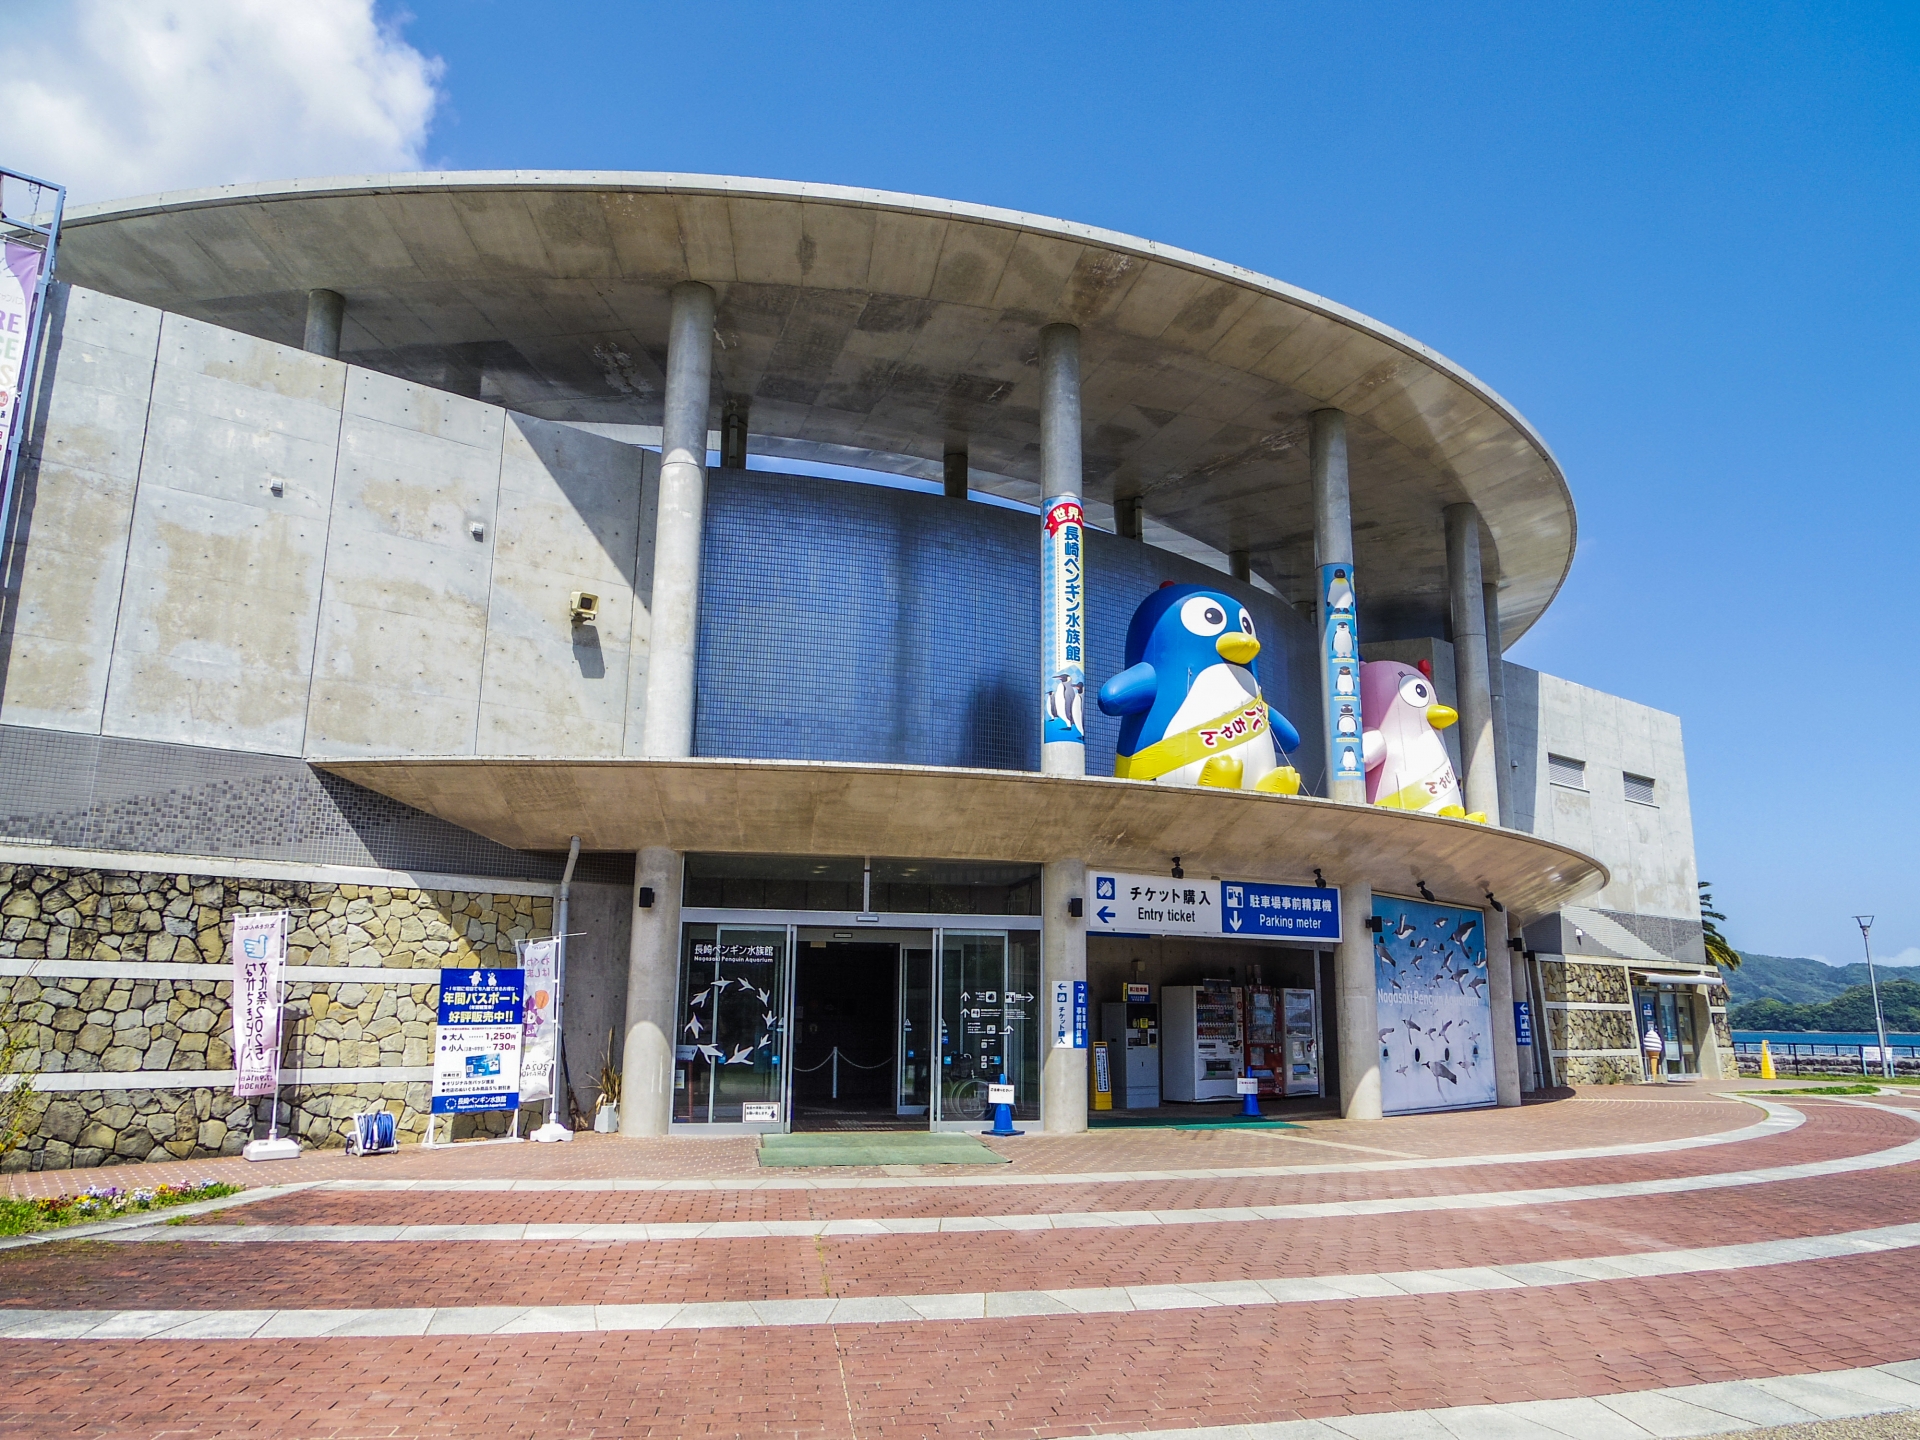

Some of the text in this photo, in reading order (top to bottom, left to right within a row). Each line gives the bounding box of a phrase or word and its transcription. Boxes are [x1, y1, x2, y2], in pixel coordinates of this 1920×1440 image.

[1063, 525, 1081, 662] 長崎ペンギン水族館
[1129, 885, 1211, 906] チケット購入
[1249, 894, 1332, 913] 駐車場事前精算機
[1137, 907, 1196, 923] Entry ticket
[1259, 914, 1322, 929] Parking meter
[694, 944, 774, 956] 長崎ペンギン水族館
[443, 991, 520, 1005] 年間パスポート
[1377, 988, 1479, 1007] Nagasaki Penguin Aquarium
[448, 1010, 514, 1023] 好評販売中!!
[1058, 1006, 1066, 1045] チケット購入
[449, 1033, 465, 1041] 大人
[485, 1032, 516, 1041] 1,250円
[448, 1044, 464, 1052] 小人
[493, 1042, 516, 1051] 730円
